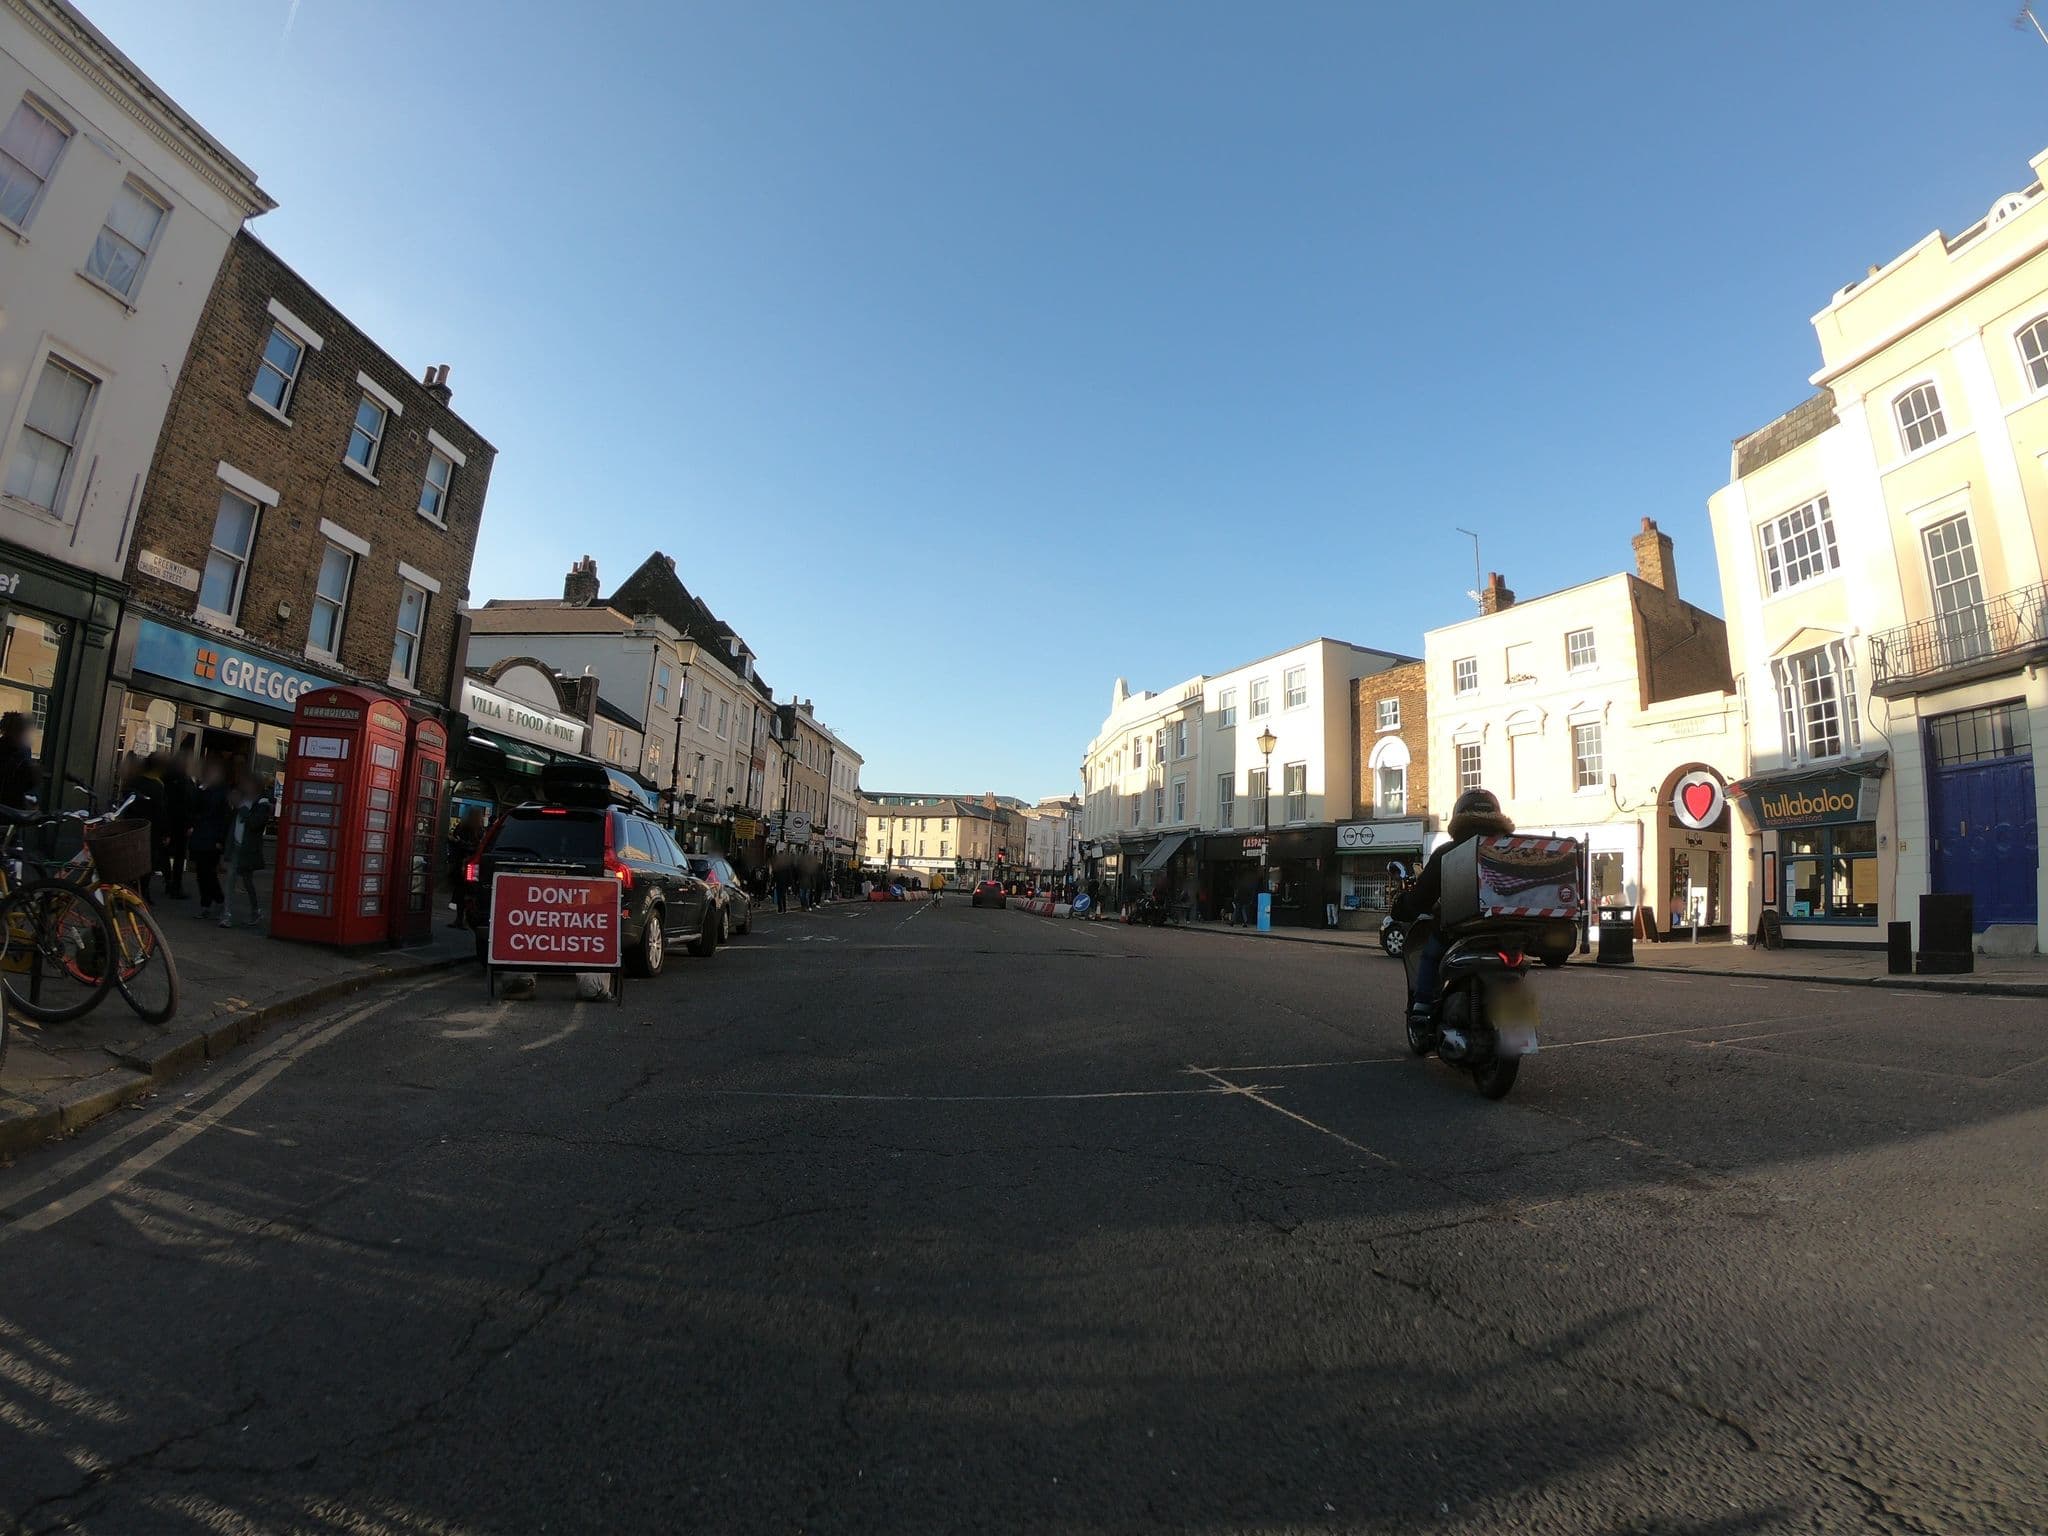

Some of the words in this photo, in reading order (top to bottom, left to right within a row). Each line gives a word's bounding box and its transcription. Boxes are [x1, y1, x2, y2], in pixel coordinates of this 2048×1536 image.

[140, 560, 161, 576] CHURCH
[162, 570, 182, 583] STREET
[153, 556, 187, 577] GREENWICH
[516, 711, 543, 731] FOOD
[545, 721, 552, 735] &
[554, 725, 575, 742] WINE
[1760, 788, 1854, 818] hullabaloo
[527, 886, 591, 905] DON'T
[508, 909, 608, 929] OVERTAKE
[510, 933, 605, 953] CYCLISTS
